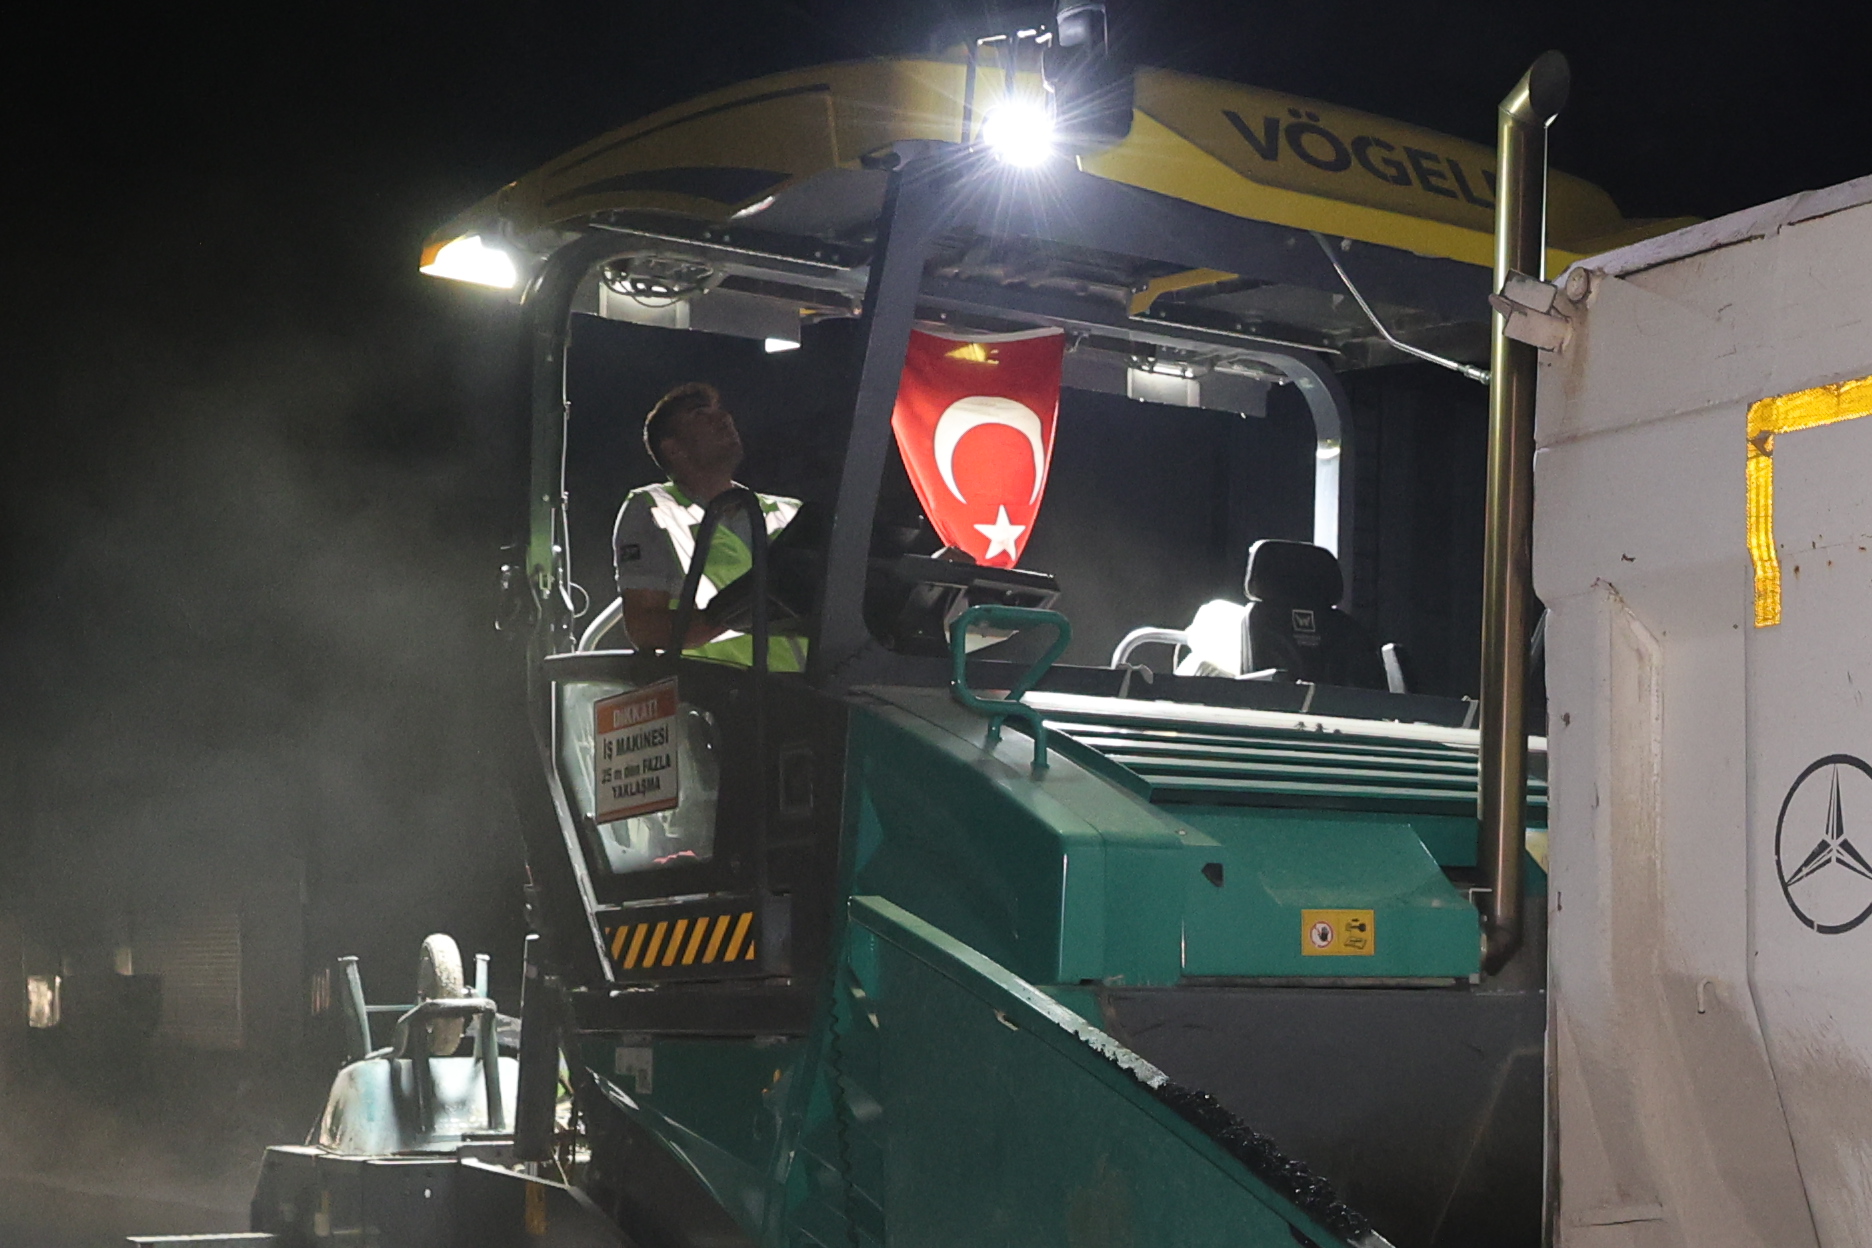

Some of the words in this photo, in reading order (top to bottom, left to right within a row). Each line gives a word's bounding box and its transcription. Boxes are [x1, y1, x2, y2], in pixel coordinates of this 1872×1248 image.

[616, 722, 669, 756] MAKİNESİ
[643, 754, 671, 774] FAZLA
[612, 775, 661, 798] YAKLAŞMA
